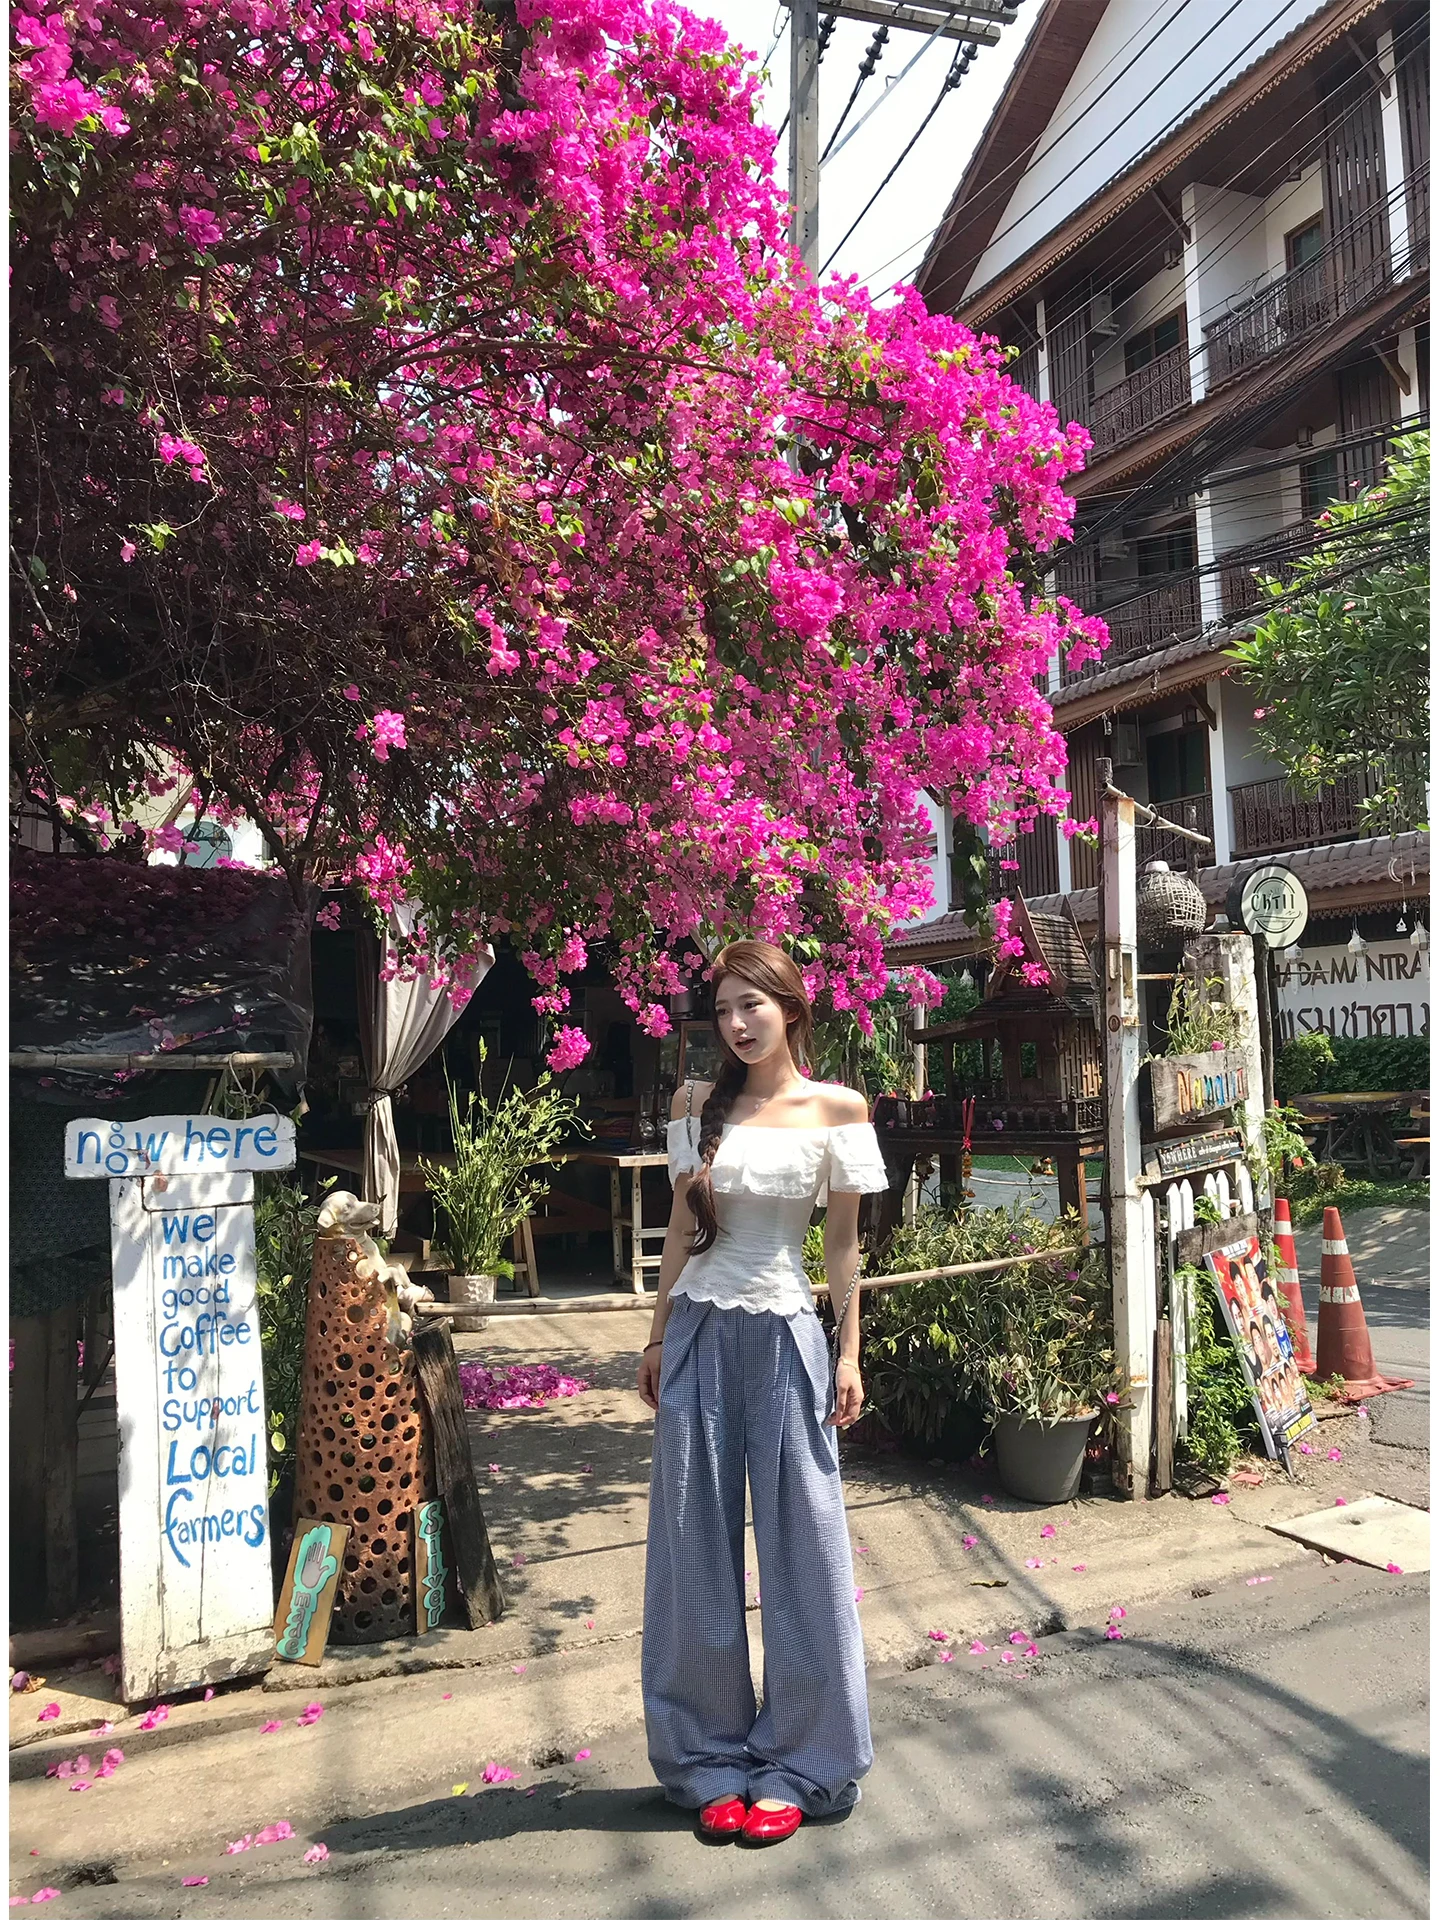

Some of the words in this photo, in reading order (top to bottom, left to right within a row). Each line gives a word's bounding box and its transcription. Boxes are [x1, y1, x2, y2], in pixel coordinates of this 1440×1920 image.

[182, 1119, 279, 1162] here
[161, 1213, 217, 1245] we
[162, 1246, 237, 1280] make
[162, 1279, 231, 1320] good
[159, 1311, 251, 1358] Coffee
[162, 1360, 197, 1394] to
[162, 1379, 260, 1432] Support
[166, 1433, 257, 1486] Local
[284, 1590, 311, 1656] made
